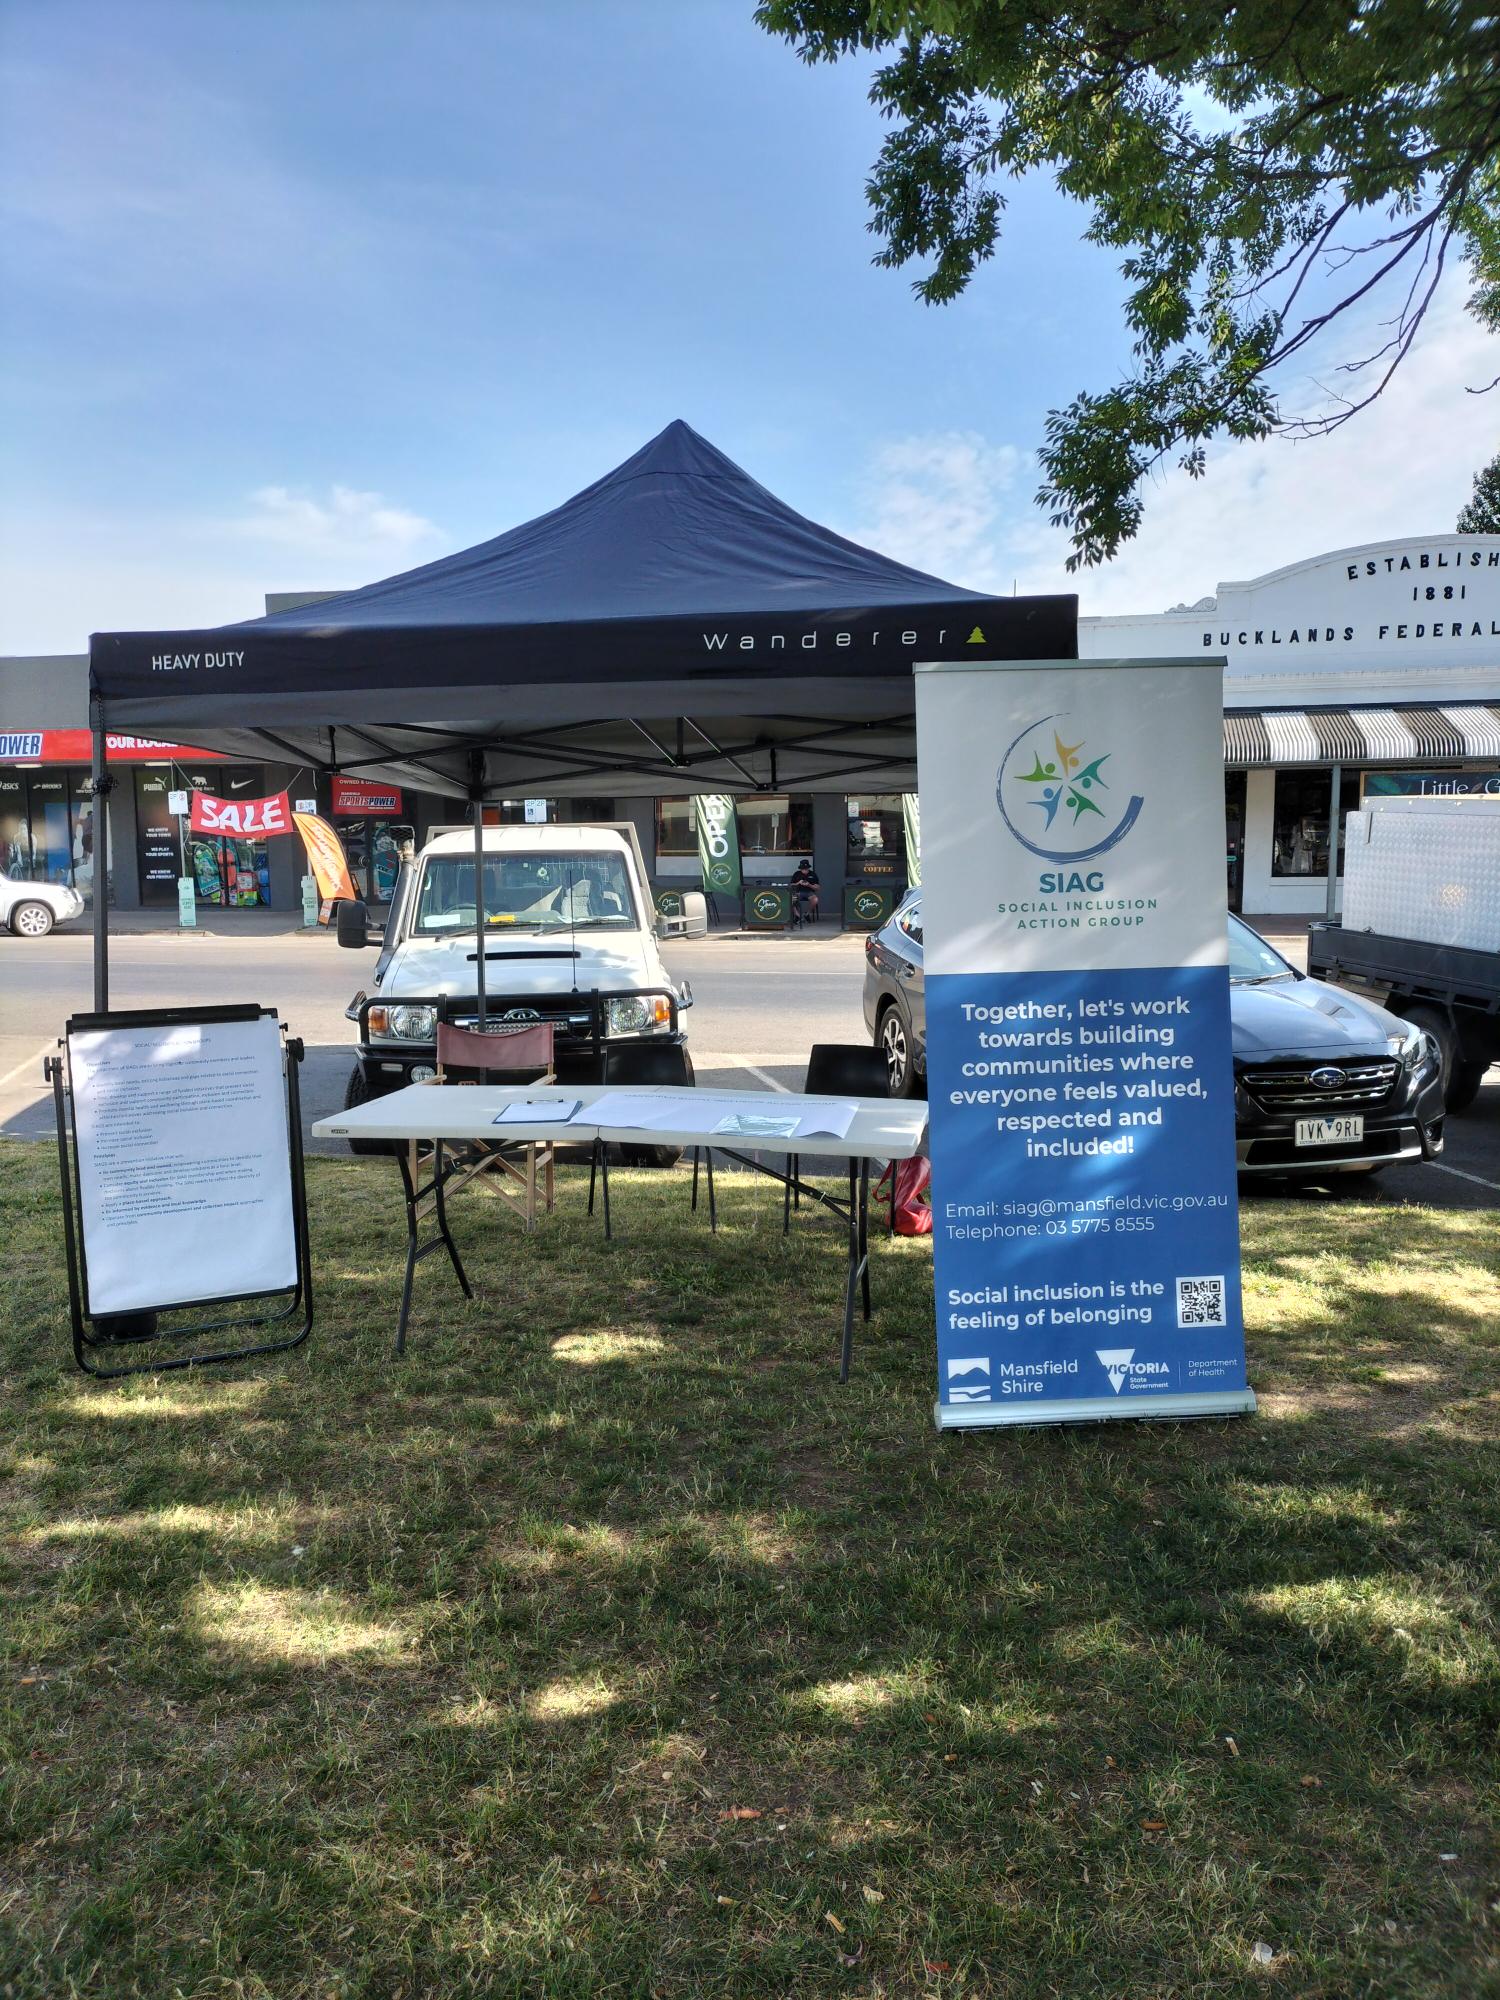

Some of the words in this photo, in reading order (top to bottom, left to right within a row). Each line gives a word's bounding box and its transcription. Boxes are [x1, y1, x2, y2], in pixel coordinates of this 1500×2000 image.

[1348, 552, 1500, 580] ESTABLISH
[1413, 585, 1466, 601] 1881
[1203, 627, 1354, 646] BUCKLANDS
[1379, 621, 1500, 640] FEDERAL
[152, 653, 200, 670] HEAVY
[204, 651, 245, 668] DUTY
[106, 736, 135, 748] OUR
[1421, 779, 1469, 795] Little
[200, 797, 285, 833] SALE
[1039, 871, 1104, 894] SIAG
[997, 902, 1058, 913] SOCIAL
[1066, 898, 1158, 911] INCLUSION
[1016, 918, 1080, 930] ACTION
[1088, 915, 1144, 927] GROUP
[961, 1000, 1073, 1024] Together,
[1079, 998, 1125, 1018] let's
[1131, 996, 1191, 1015] work
[979, 1027, 1073, 1048] towards
[1080, 1024, 1175, 1046] building
[961, 1053, 1114, 1077] communities
[1119, 1052, 1194, 1071] where
[950, 1085, 1057, 1108] everyone
[1063, 1081, 1118, 1100] feels
[1123, 1078, 1208, 1100] valued,
[997, 1109, 1111, 1133] respected
[1119, 1106, 1162, 1126] and
[1300, 1122, 1324, 1140] 1VK
[1335, 1120, 1361, 1137] 9RL
[1026, 1136, 1134, 1158] included!
[946, 1201, 1000, 1218] Email:
[1003, 1194, 1228, 1216] siag@mansfield.vic.gov.au
[946, 1223, 1041, 1241] Telephone:
[1046, 1220, 1067, 1234] 03
[1071, 1217, 1110, 1233] 5775
[1114, 1216, 1155, 1231] 8555
[948, 1286, 1008, 1305] Social
[1014, 1282, 1104, 1303] inclusion
[1110, 1280, 1126, 1297] is
[1131, 1279, 1164, 1296] the
[948, 1312, 1019, 1331] feeling
[1025, 1308, 1045, 1325] of
[1051, 1304, 1153, 1326] belonging
[1000, 1359, 1078, 1377] Mansfield
[1103, 1362, 1170, 1376] VICTORIA
[1188, 1359, 1238, 1369] Department
[1198, 1368, 1225, 1377] Health
[1001, 1380, 1044, 1394] Shire
[1130, 1382, 1169, 1390] Government
